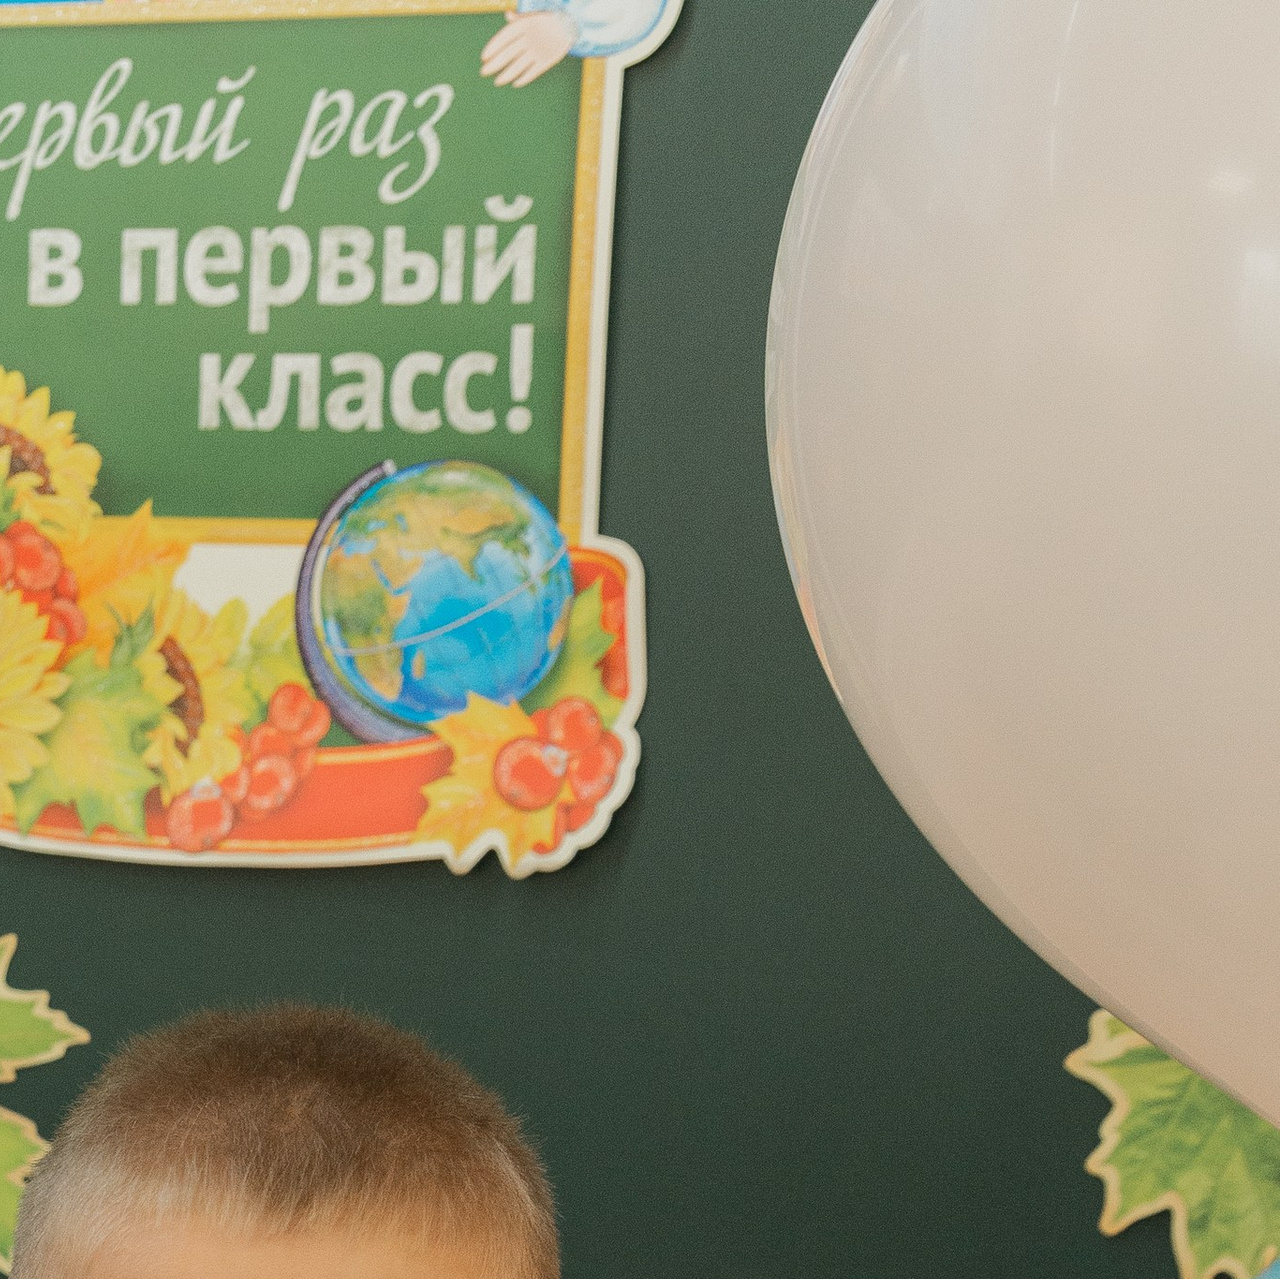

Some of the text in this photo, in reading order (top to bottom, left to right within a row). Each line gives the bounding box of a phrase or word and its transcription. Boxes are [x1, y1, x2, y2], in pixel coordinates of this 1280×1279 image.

[277, 83, 456, 213] раз
[27, 195, 538, 334] в первый
[197, 323, 536, 434] класс!
